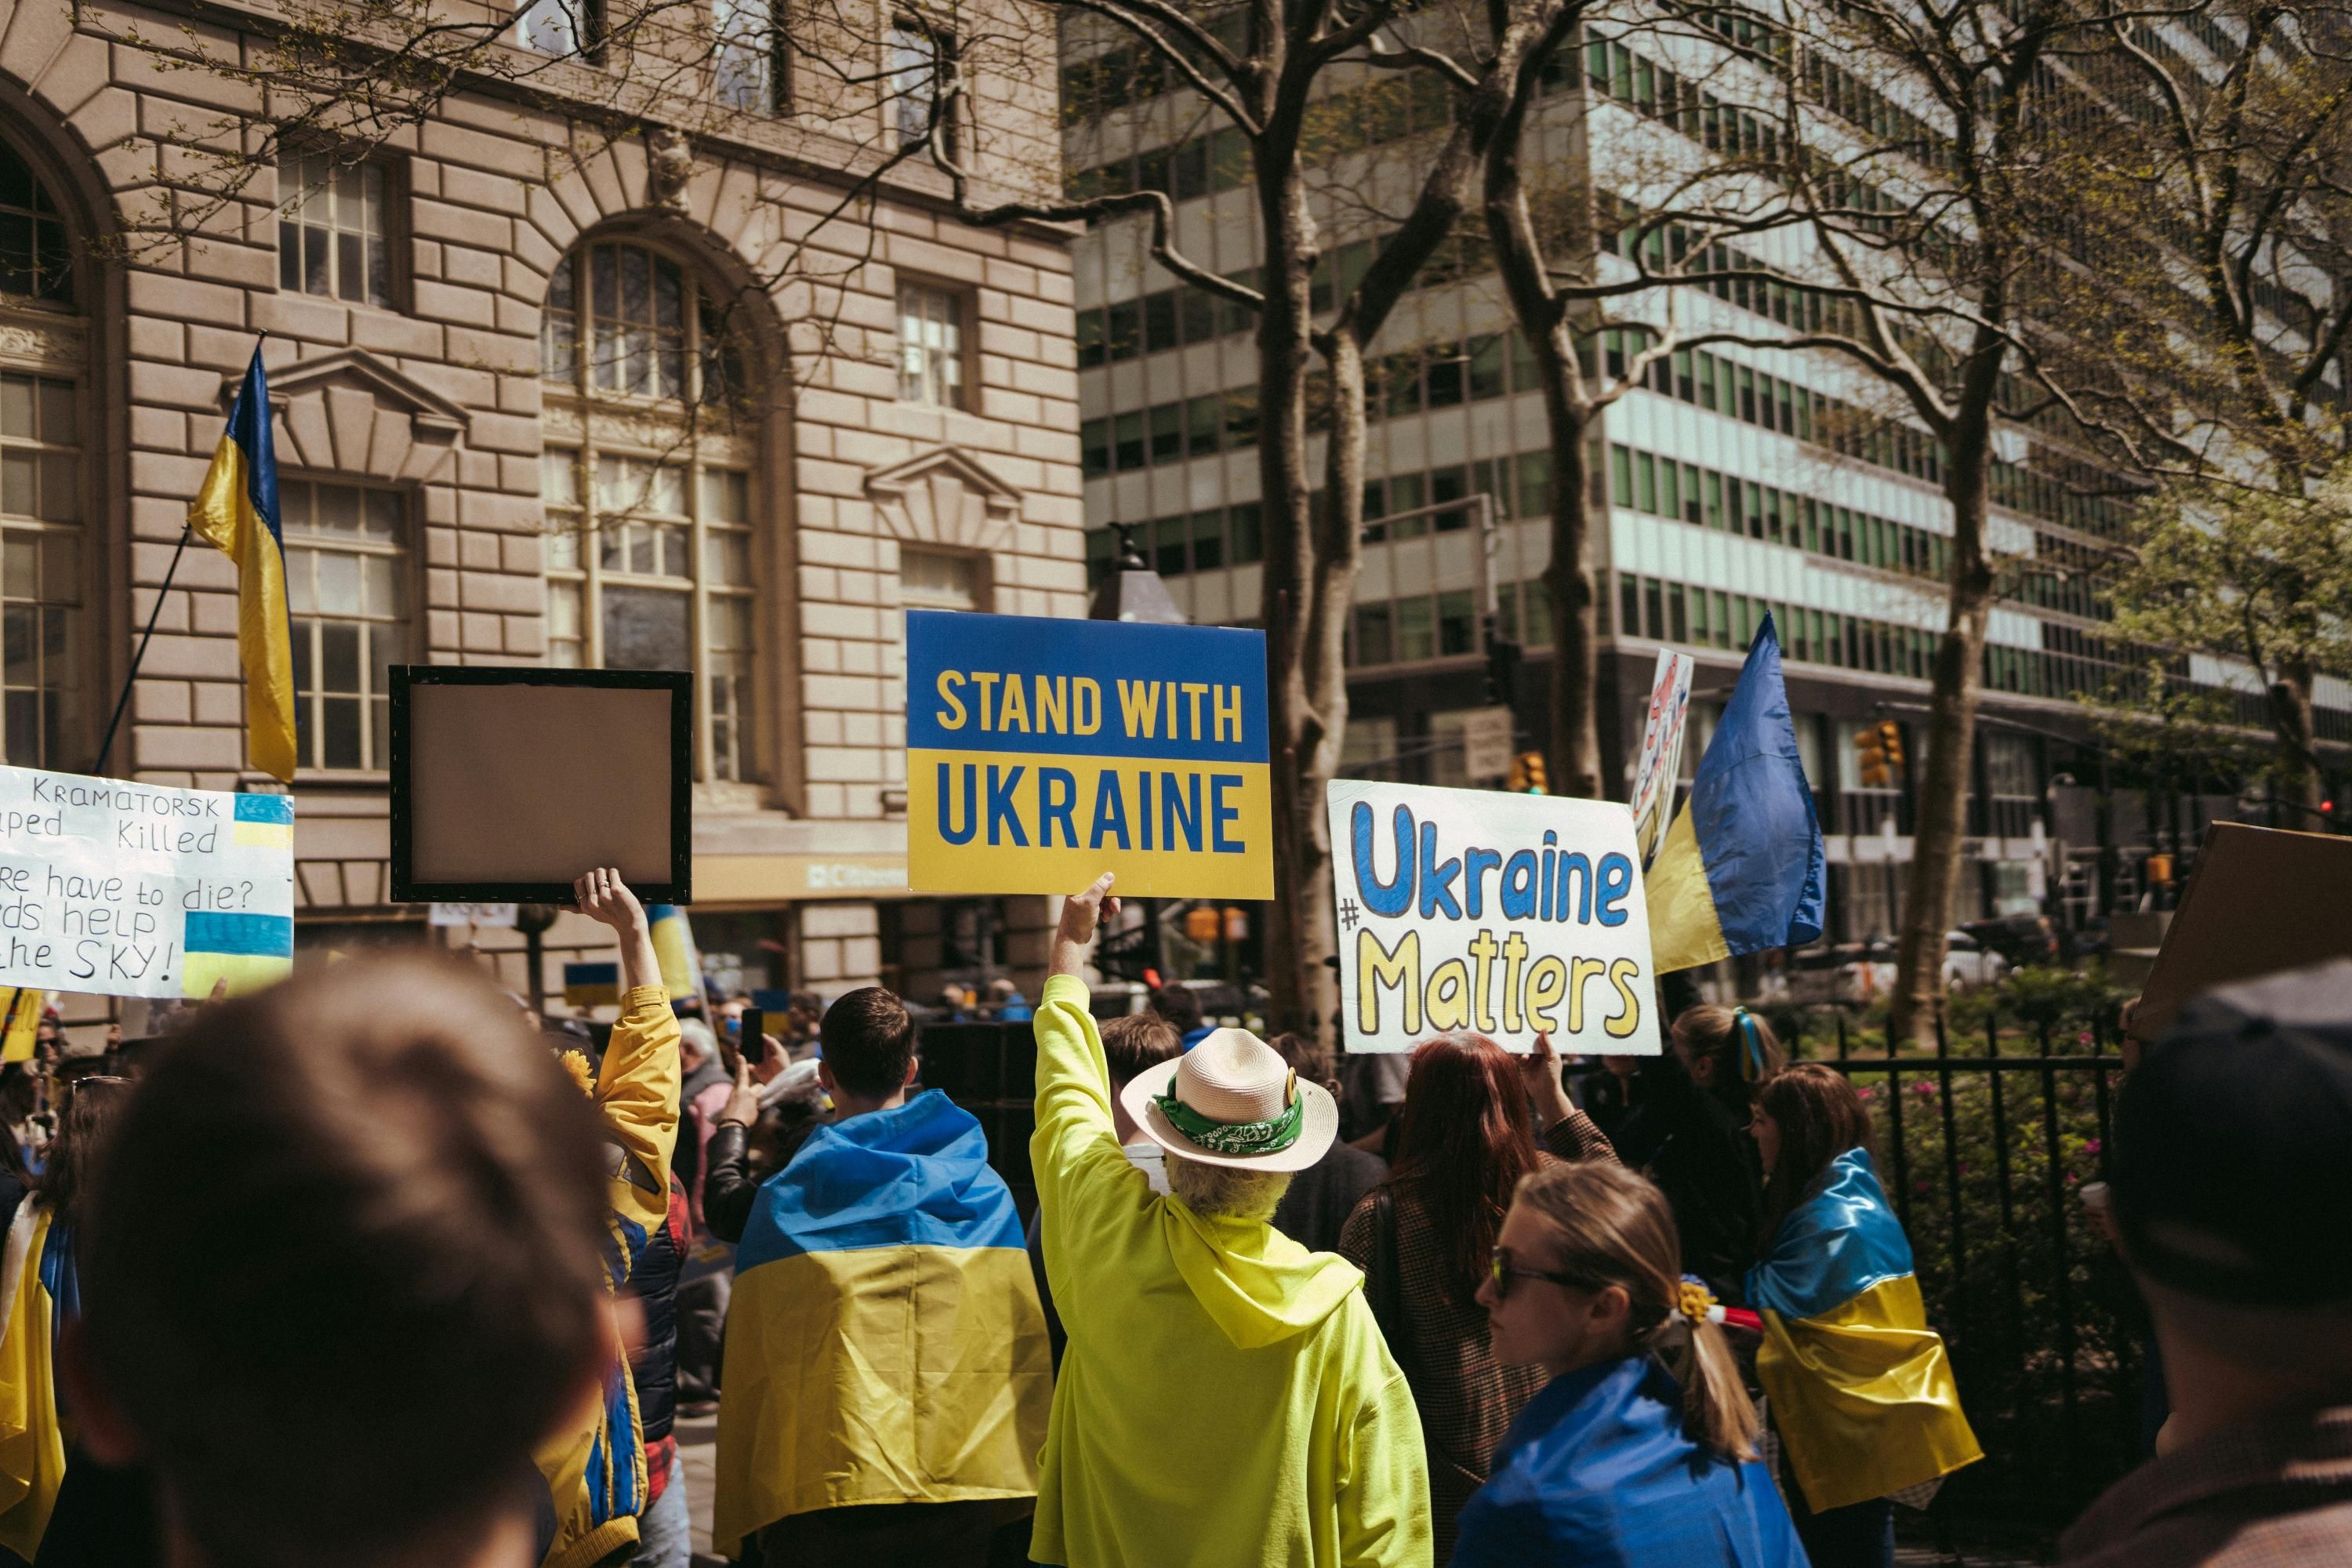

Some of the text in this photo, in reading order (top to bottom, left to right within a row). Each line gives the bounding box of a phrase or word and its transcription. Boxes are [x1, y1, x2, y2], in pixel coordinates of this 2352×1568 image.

[936, 670, 1243, 743] STAND WITH
[0, 810, 218, 853] ped Killed
[937, 762, 1246, 854] UKRAINE
[47, 865, 122, 902] have
[136, 882, 164, 906] to
[182, 879, 254, 909] die?
[1350, 800, 1634, 927] Ukraine
[0, 896, 43, 931] ds
[0, 937, 53, 969] he
[1356, 927, 1640, 1039] Matters
